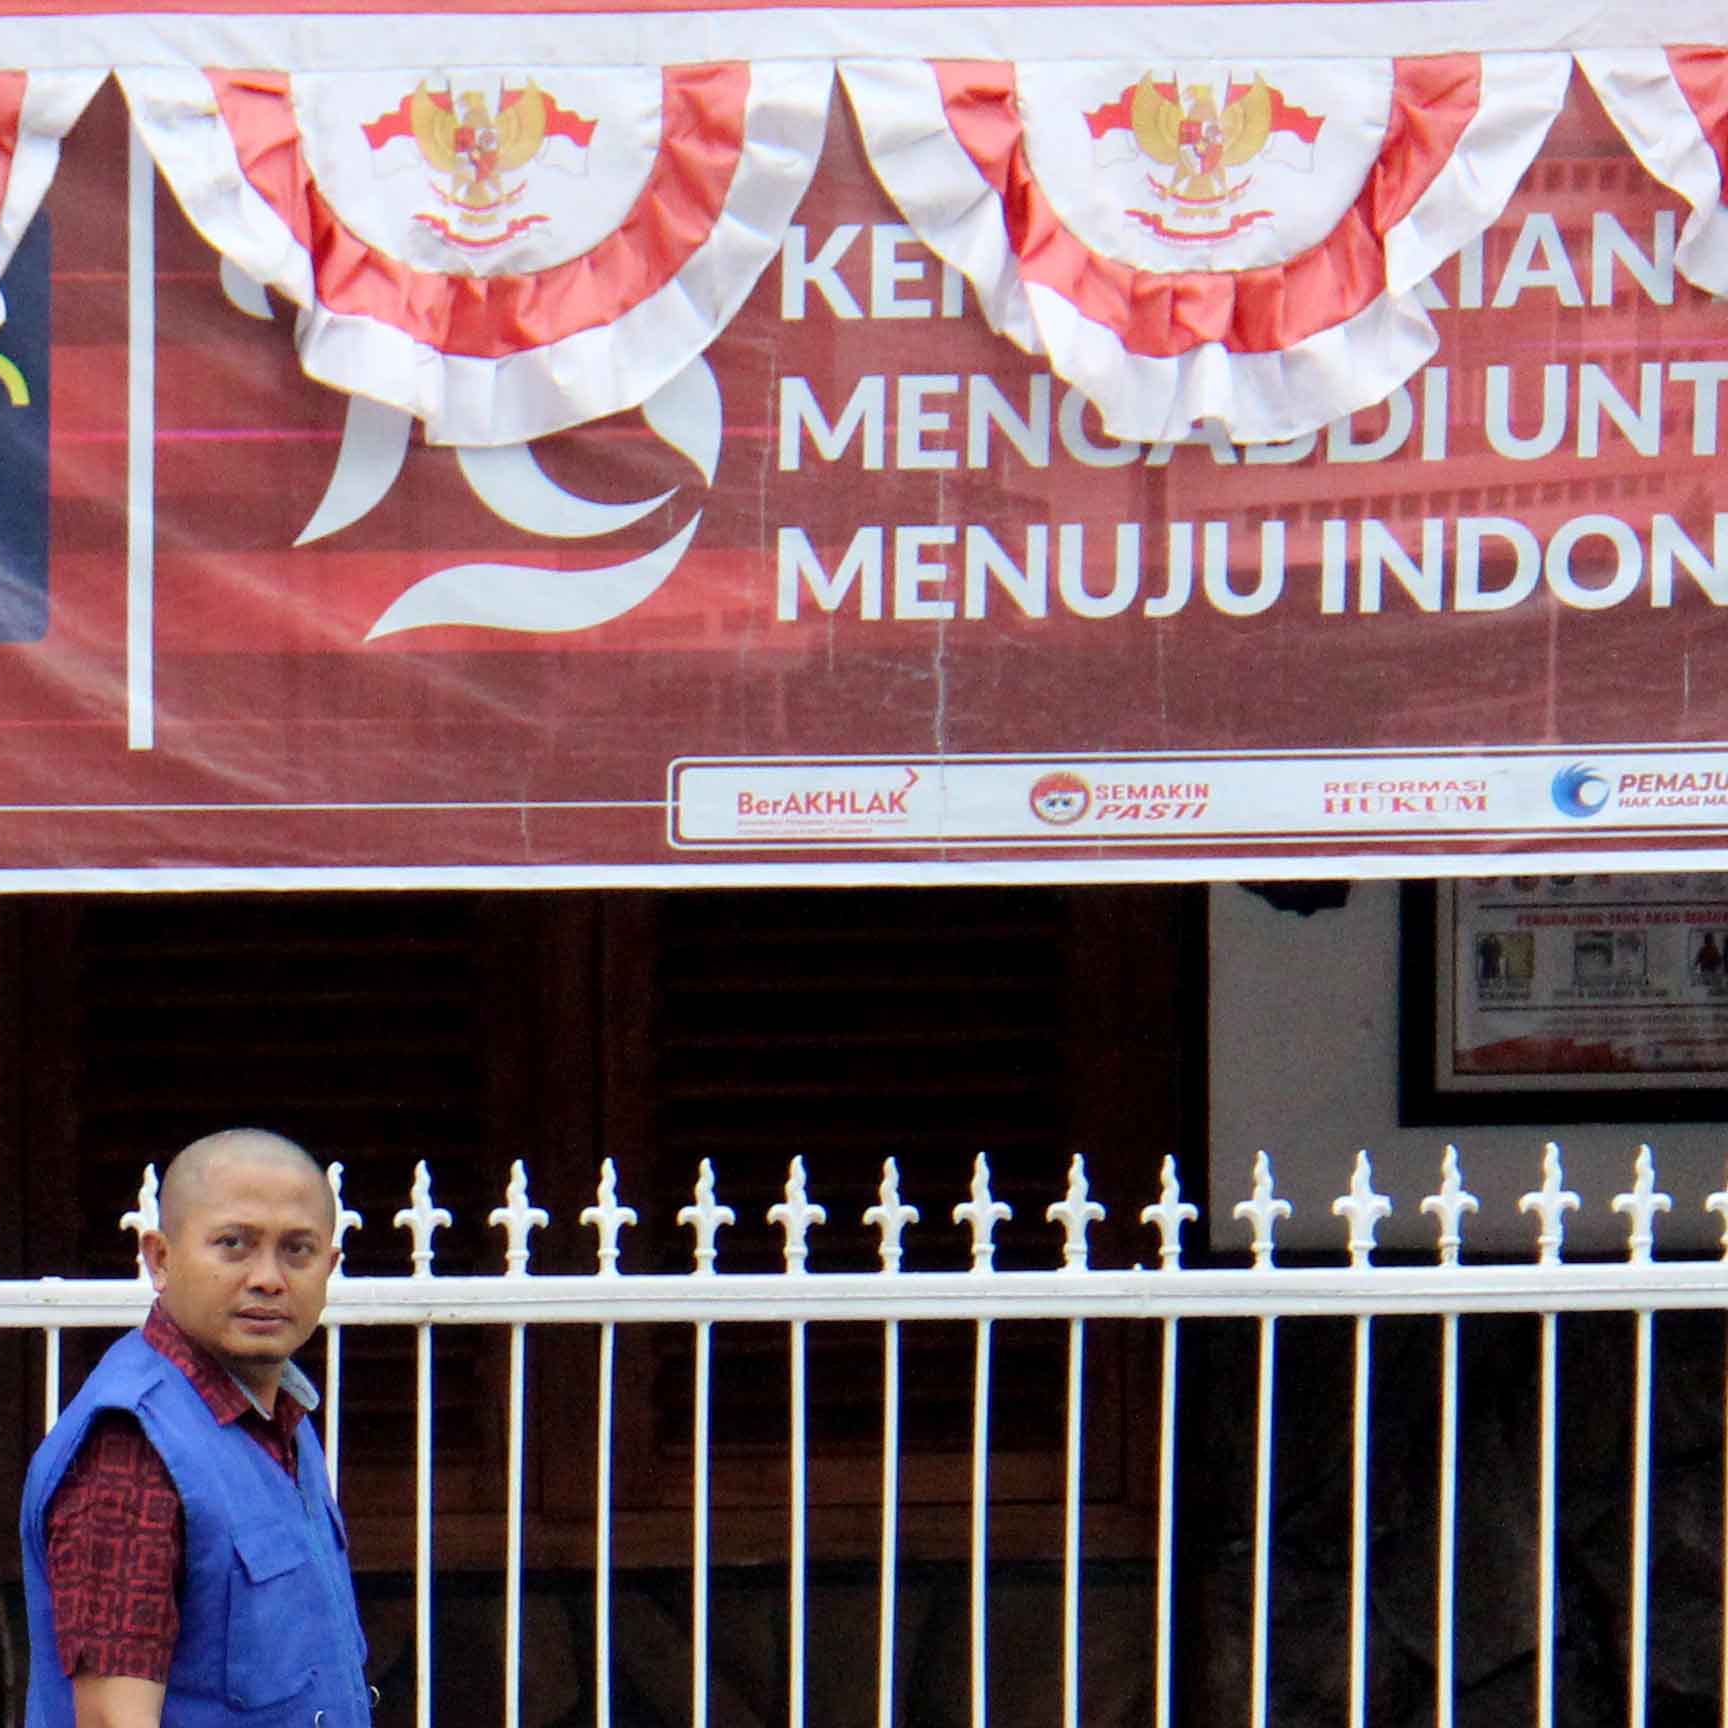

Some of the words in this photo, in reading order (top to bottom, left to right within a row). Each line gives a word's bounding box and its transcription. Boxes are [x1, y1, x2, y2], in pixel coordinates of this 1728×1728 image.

[777, 520, 1286, 622] MENUJU
[1323, 513, 1728, 617] INDON
[1095, 783, 1210, 800] SEMAKIN
[1323, 780, 1488, 795] REFORMASI
[737, 790, 909, 816] BerAKHLAK
[1322, 795, 1488, 814] HUKUM
[1618, 796, 1650, 808] HAK
[1655, 795, 1700, 807] ASASI
[1095, 802, 1209, 821] PASTI
